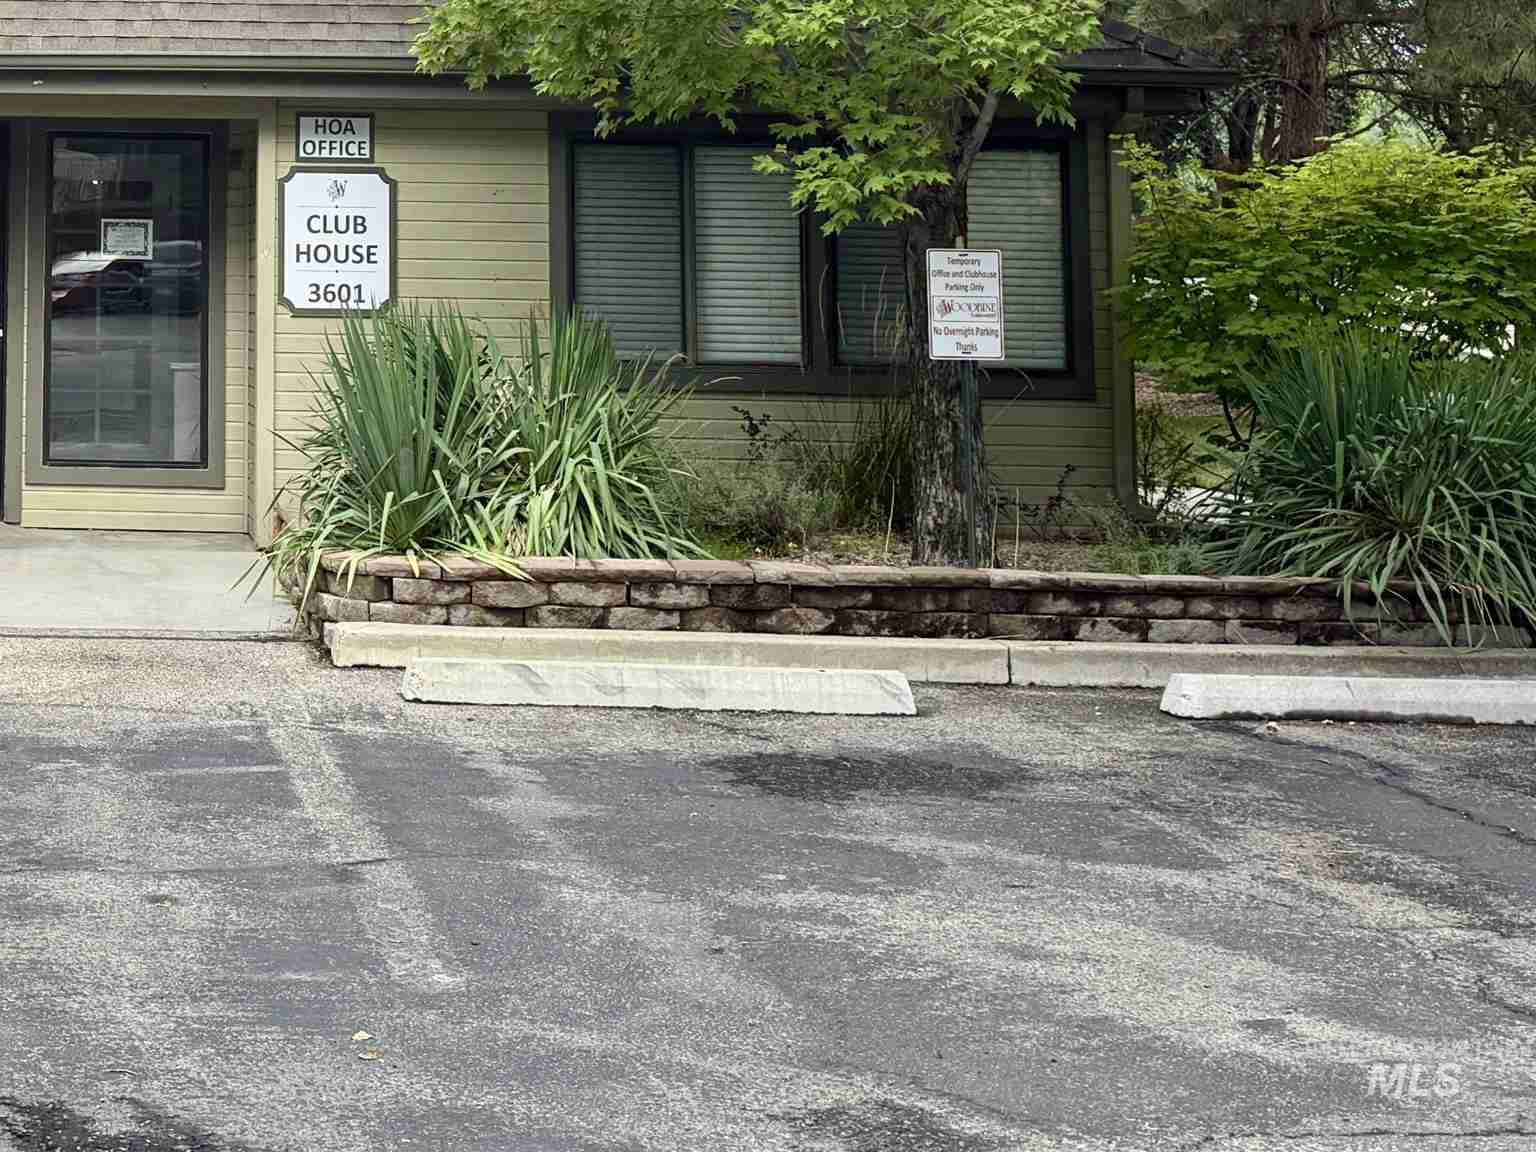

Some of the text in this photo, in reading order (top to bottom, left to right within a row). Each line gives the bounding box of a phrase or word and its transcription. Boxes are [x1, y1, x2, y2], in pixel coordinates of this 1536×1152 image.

[314, 118, 356, 136] HOA
[302, 140, 367, 157] OFFICE
[307, 215, 367, 234] CLUB
[296, 244, 378, 264] HOUSE
[947, 257, 981, 266] Temporary
[952, 270, 963, 278] and
[308, 283, 365, 303] 3601
[945, 283, 984, 293] Parking Only
[934, 327, 999, 338] No Overnight Parking
[955, 342, 977, 351] Thanks
